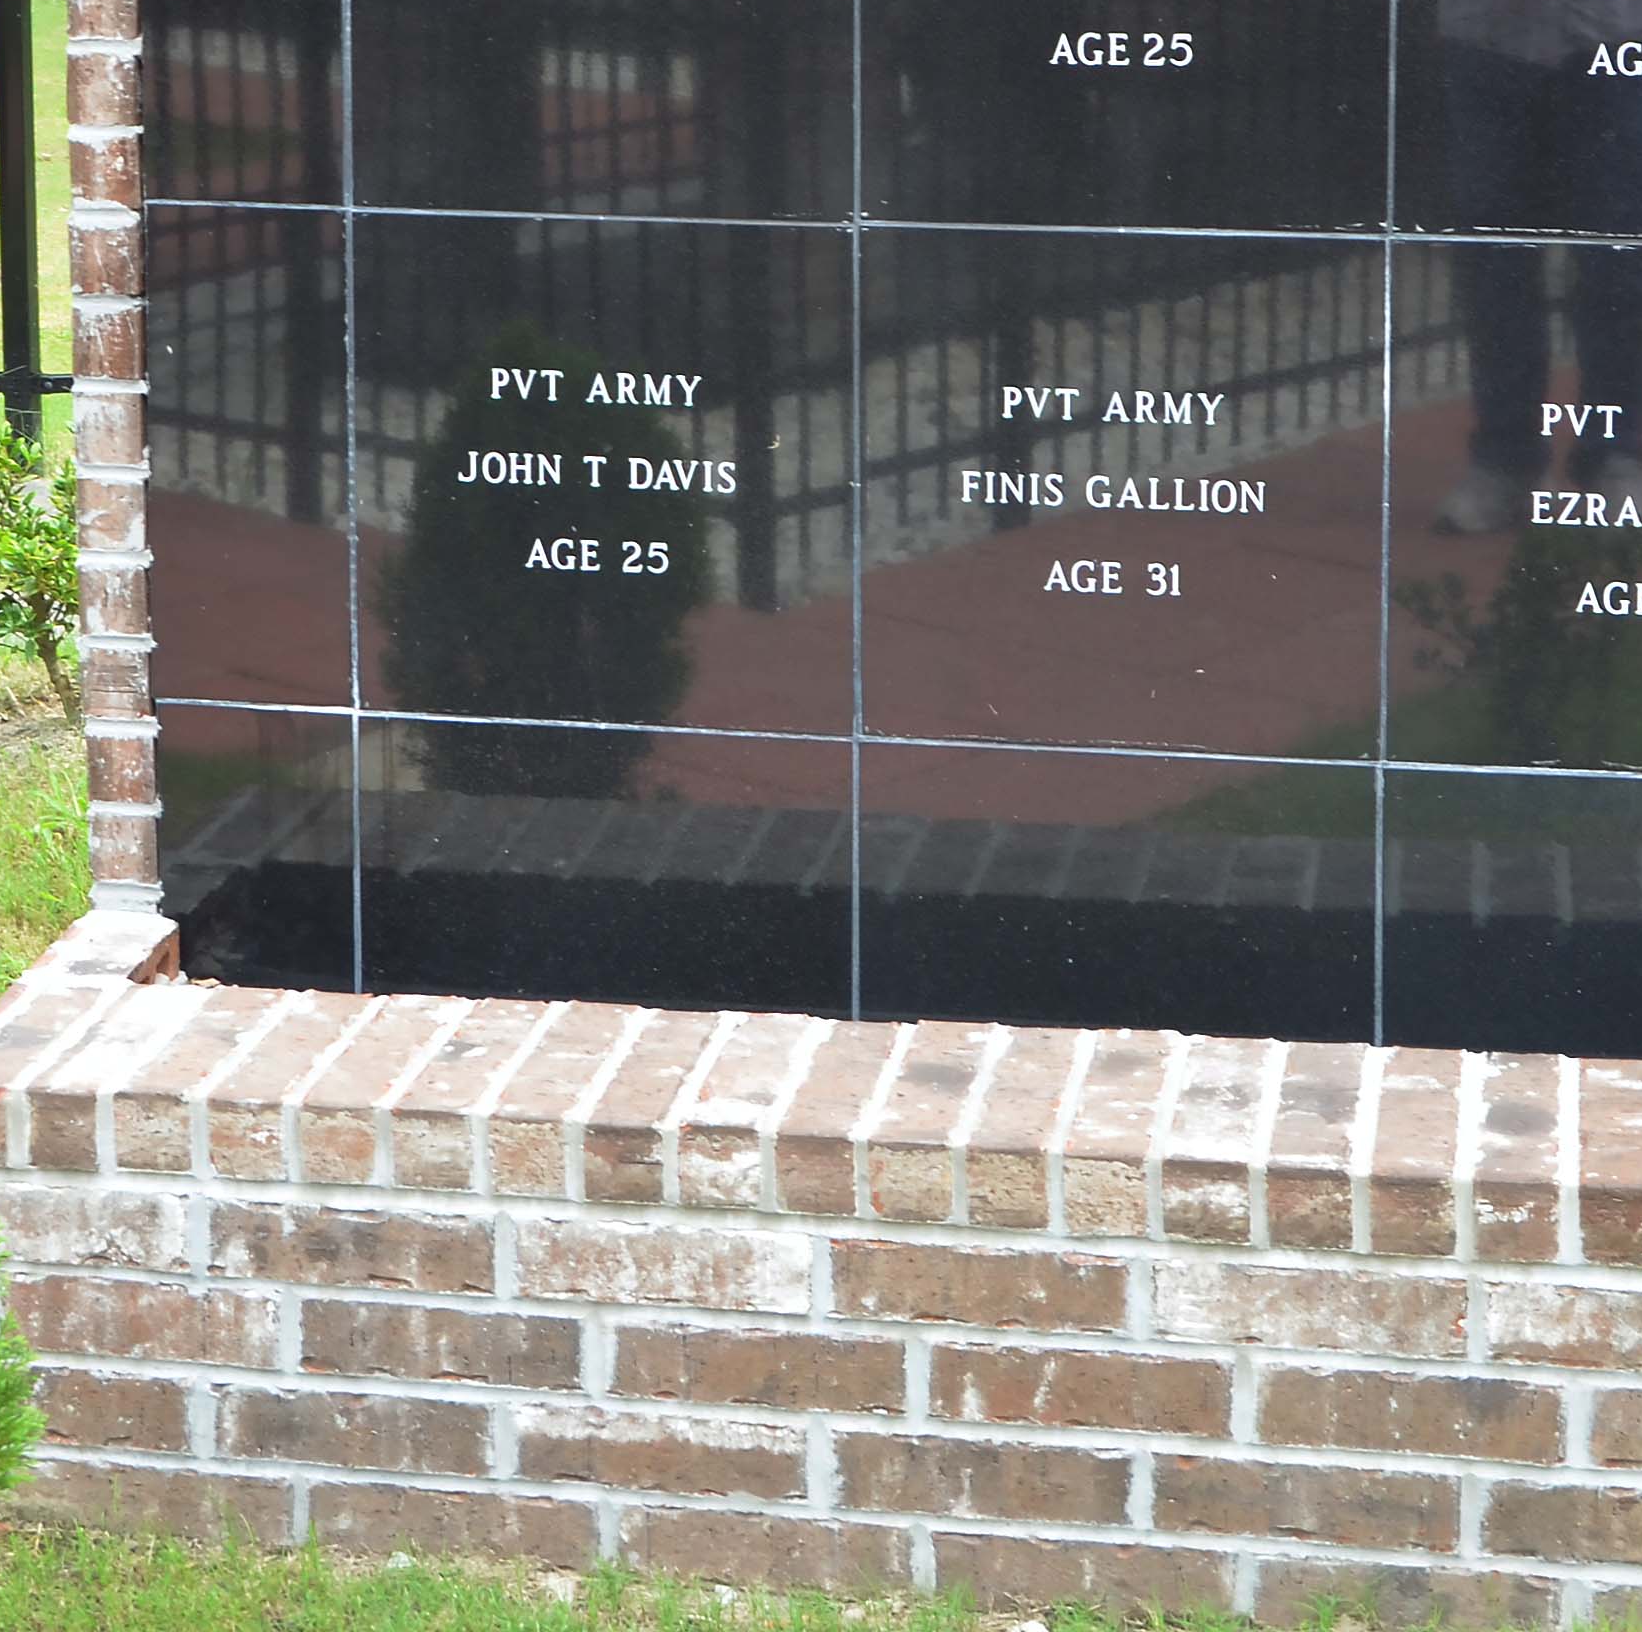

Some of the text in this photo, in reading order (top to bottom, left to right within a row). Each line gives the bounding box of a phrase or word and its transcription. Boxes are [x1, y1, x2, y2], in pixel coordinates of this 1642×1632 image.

[1048, 30, 1194, 68] AGE 25
[489, 366, 703, 408] PVT ARMY
[1001, 385, 1226, 427] PVT ARMY
[1539, 402, 1624, 440] PVT
[456, 450, 737, 495] JOHN T DAVIS
[960, 469, 1267, 514] FINIS GALLION
[524, 537, 670, 575] AGE 25
[1042, 559, 1182, 597] AGE 31
